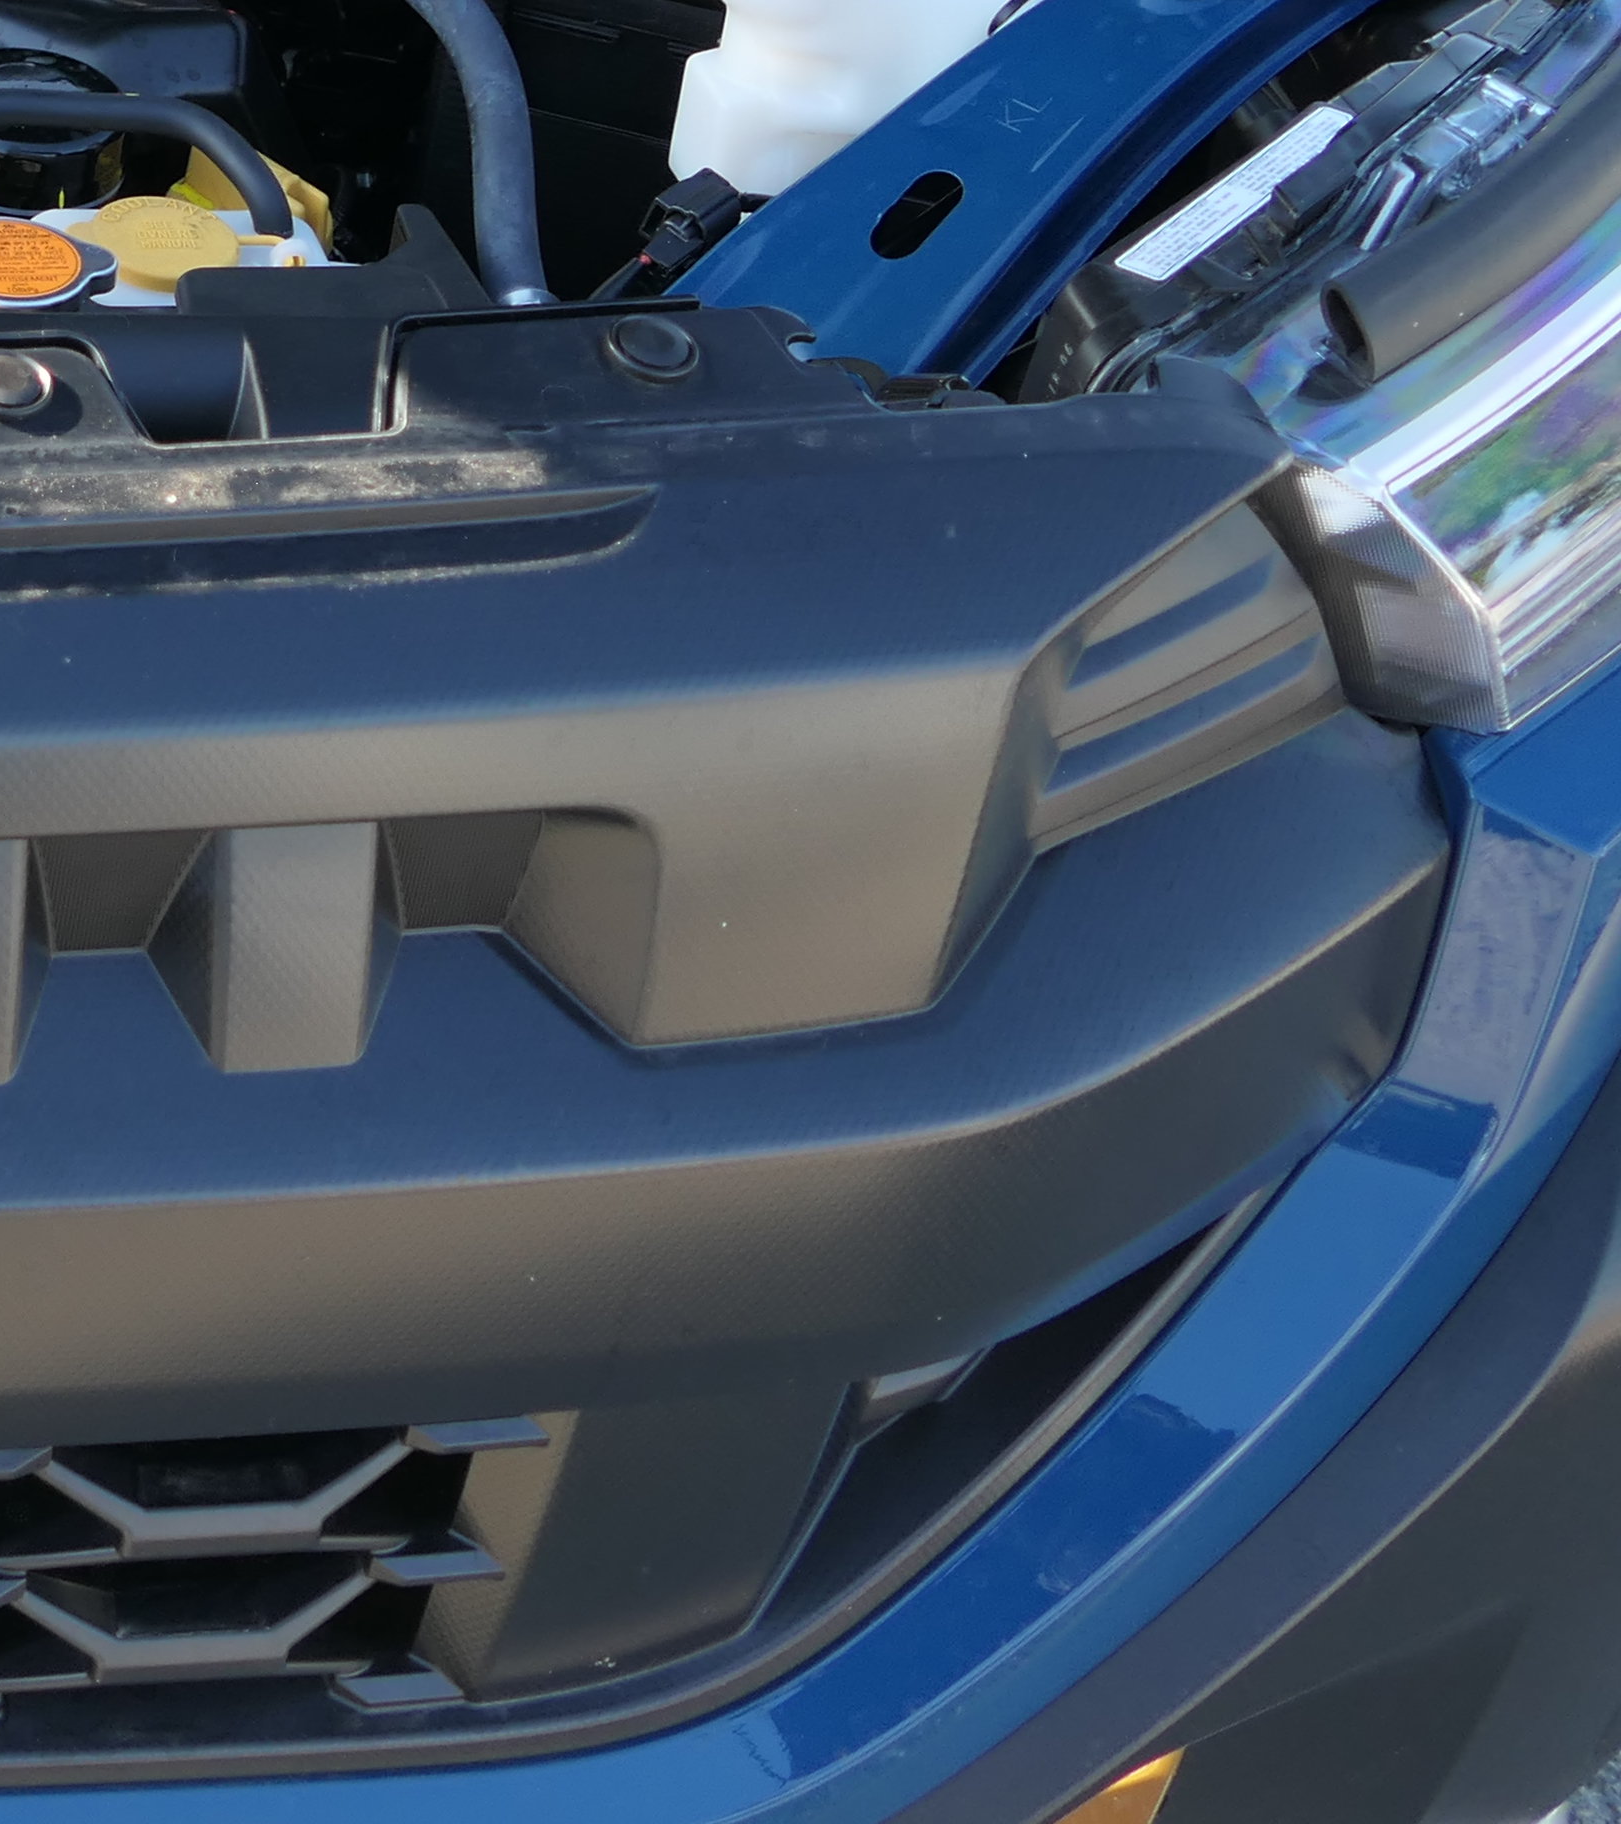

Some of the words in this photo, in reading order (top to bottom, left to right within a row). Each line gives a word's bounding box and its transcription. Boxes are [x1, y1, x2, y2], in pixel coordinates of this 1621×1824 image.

[997, 96, 1053, 134] KL
[101, 197, 217, 223] COOLANT
[140, 239, 200, 250] MANUAL
